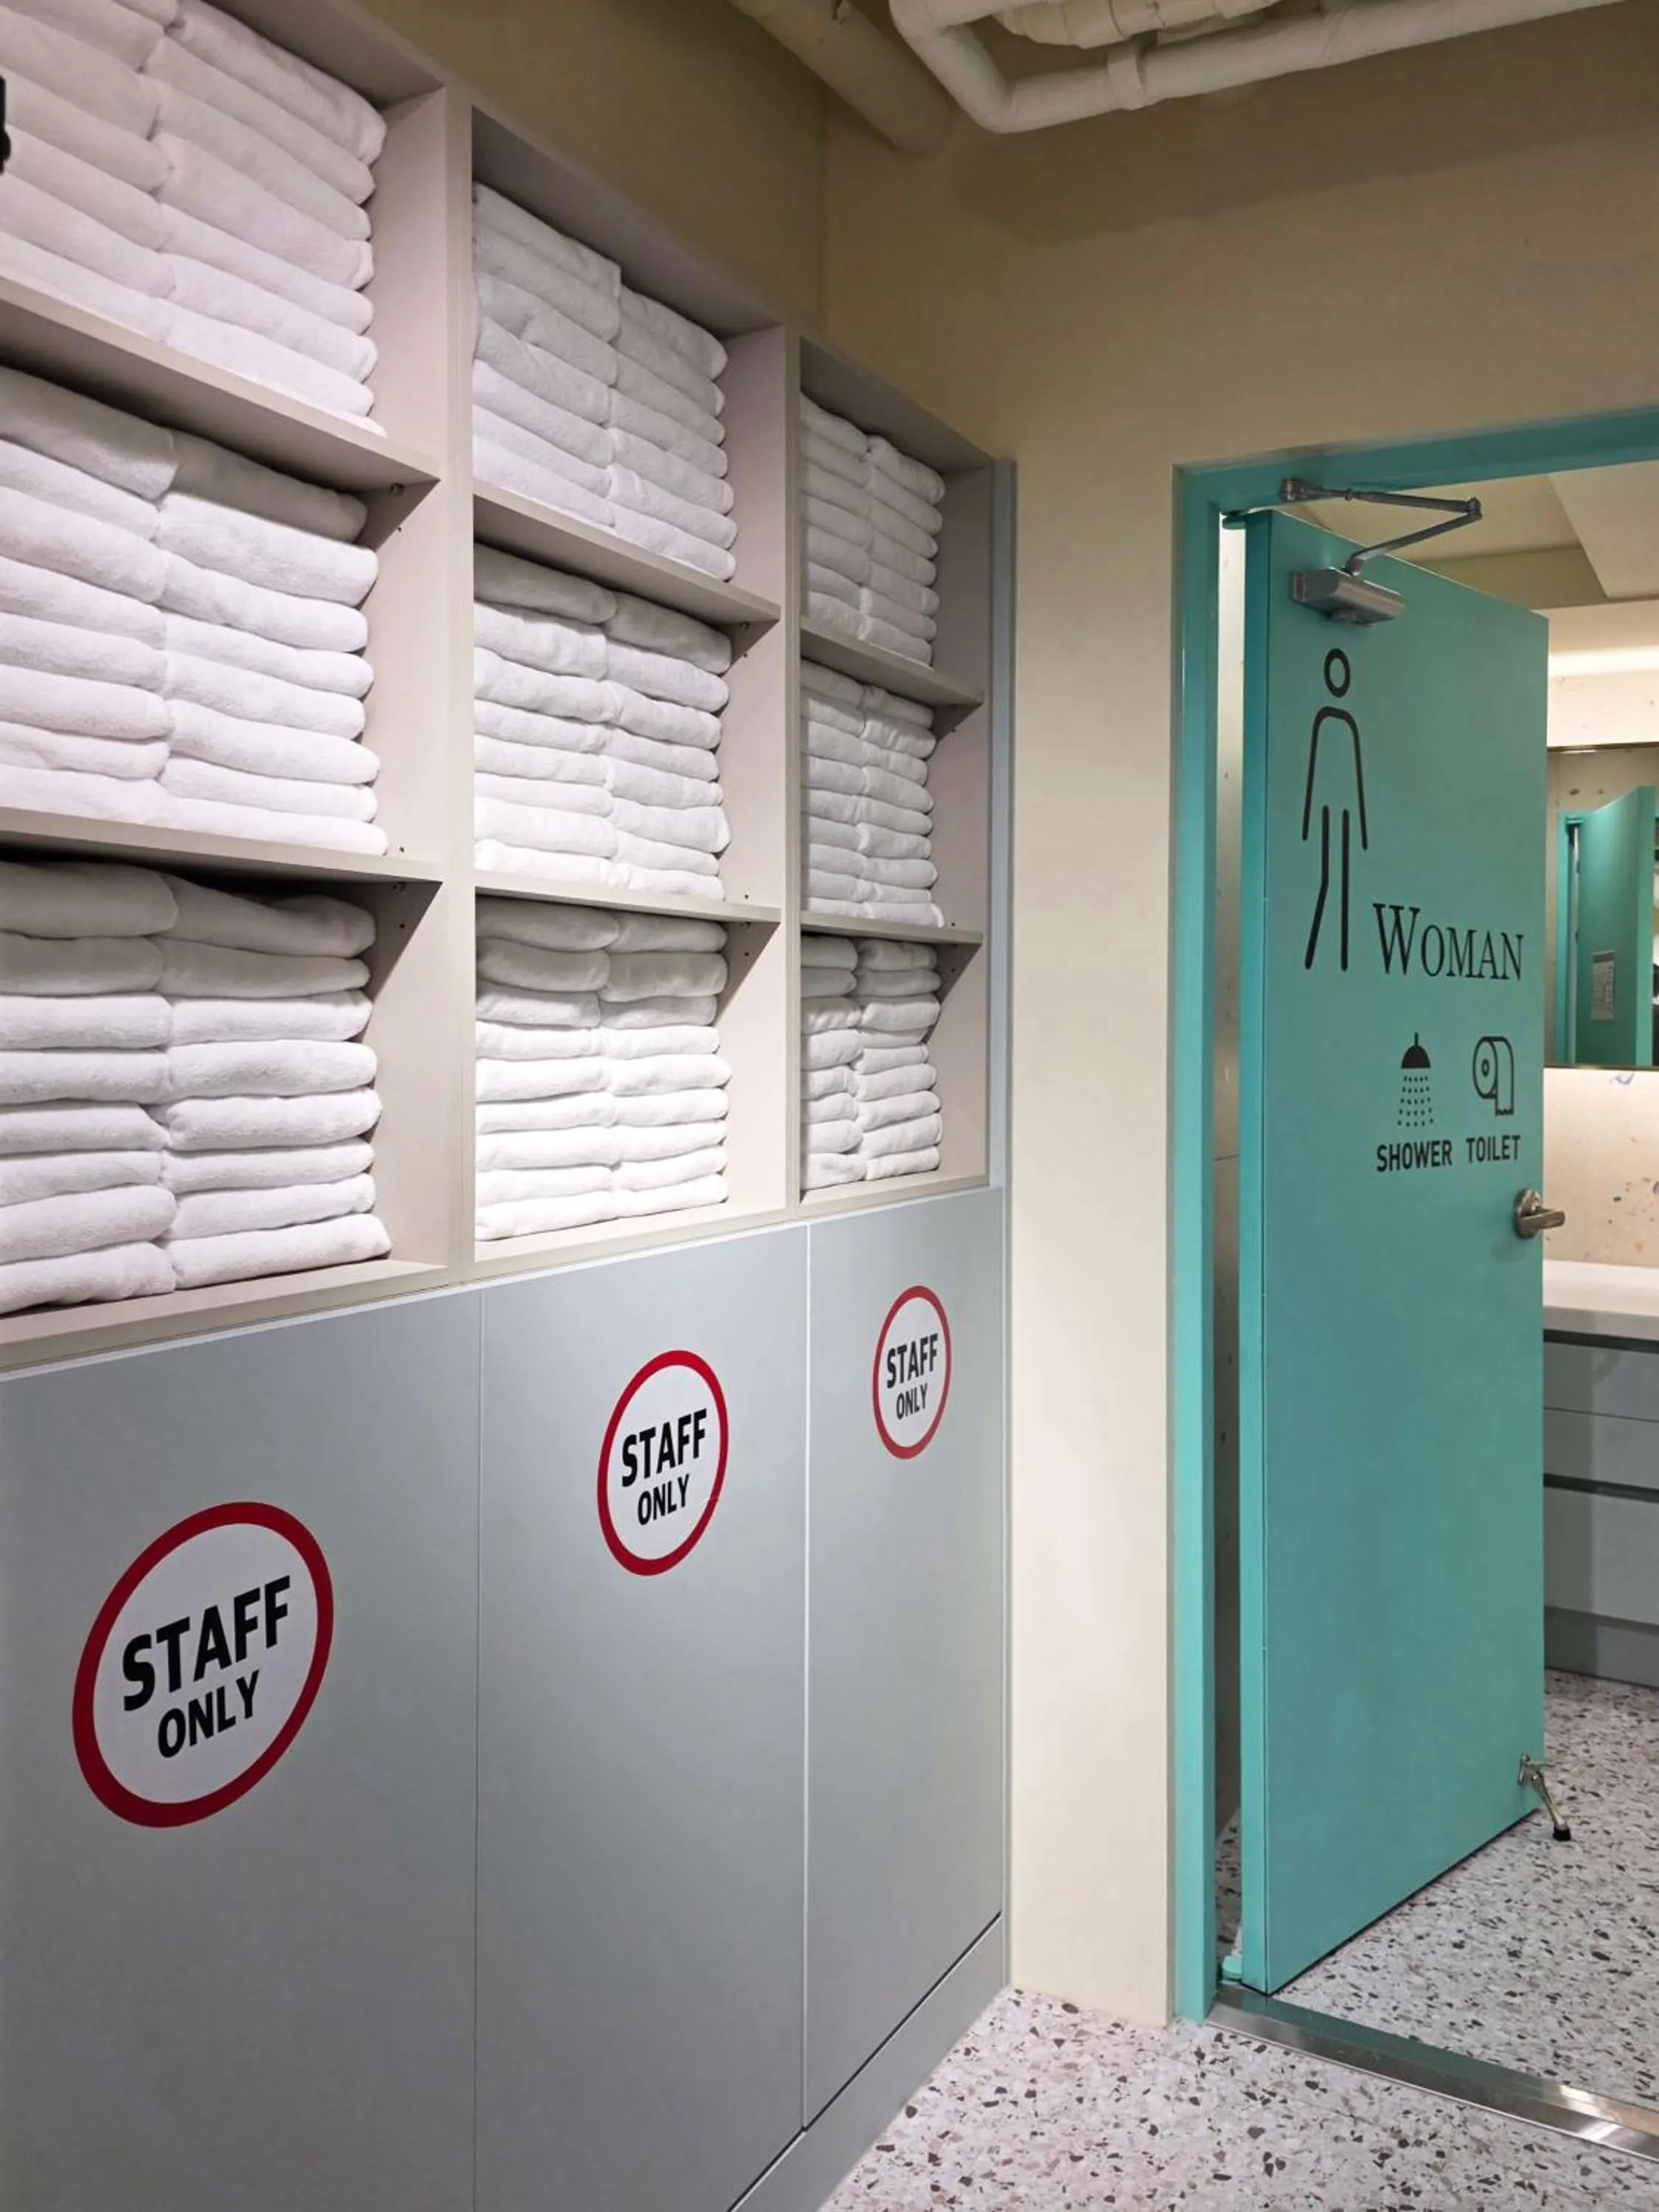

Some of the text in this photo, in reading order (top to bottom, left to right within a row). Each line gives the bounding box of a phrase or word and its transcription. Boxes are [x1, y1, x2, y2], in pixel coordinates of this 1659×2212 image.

[1372, 902, 1525, 981] WOMAN
[1376, 1139, 1453, 1172] SHOWER
[1465, 1134, 1521, 1163] TOILET
[886, 1332, 939, 1389] STAFF
[895, 1382, 928, 1420] ONLY
[622, 1408, 708, 1487] STAFF
[637, 1473, 690, 1526] ONLY
[122, 1574, 291, 1711] STAFF
[157, 1669, 260, 1759] ONLY
